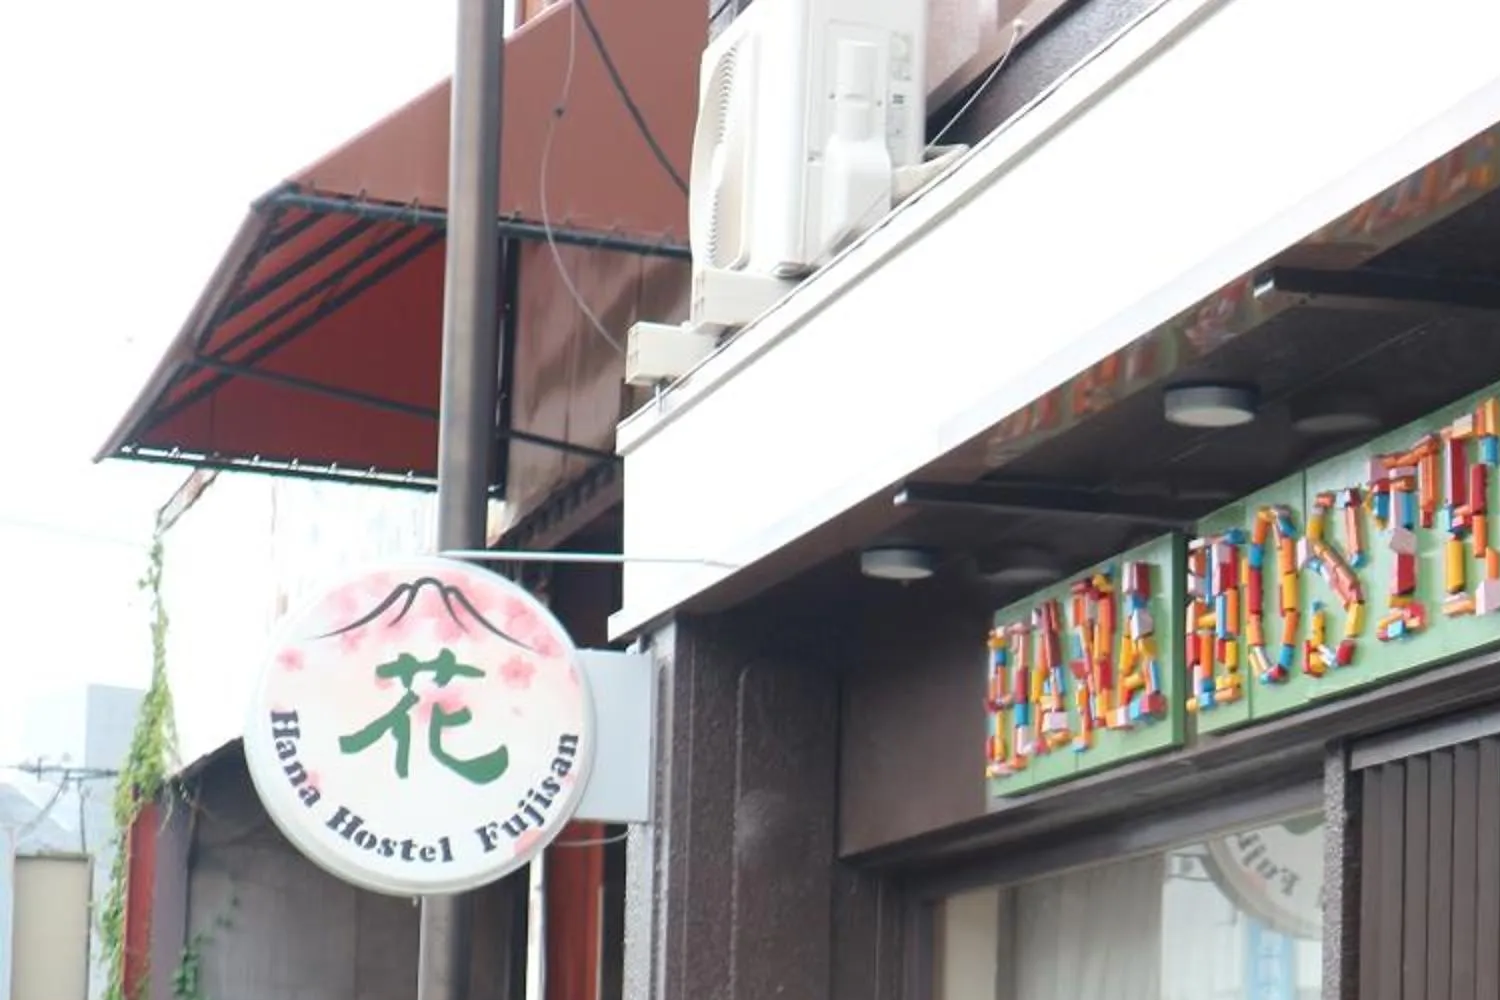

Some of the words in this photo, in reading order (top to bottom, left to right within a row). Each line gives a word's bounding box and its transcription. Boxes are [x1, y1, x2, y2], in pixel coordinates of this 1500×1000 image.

[338, 647, 509, 785] 花
[985, 562, 1168, 778] HANA
[270, 709, 321, 809] Hana
[326, 805, 454, 864] Hostel
[474, 732, 580, 854] Fujisan
